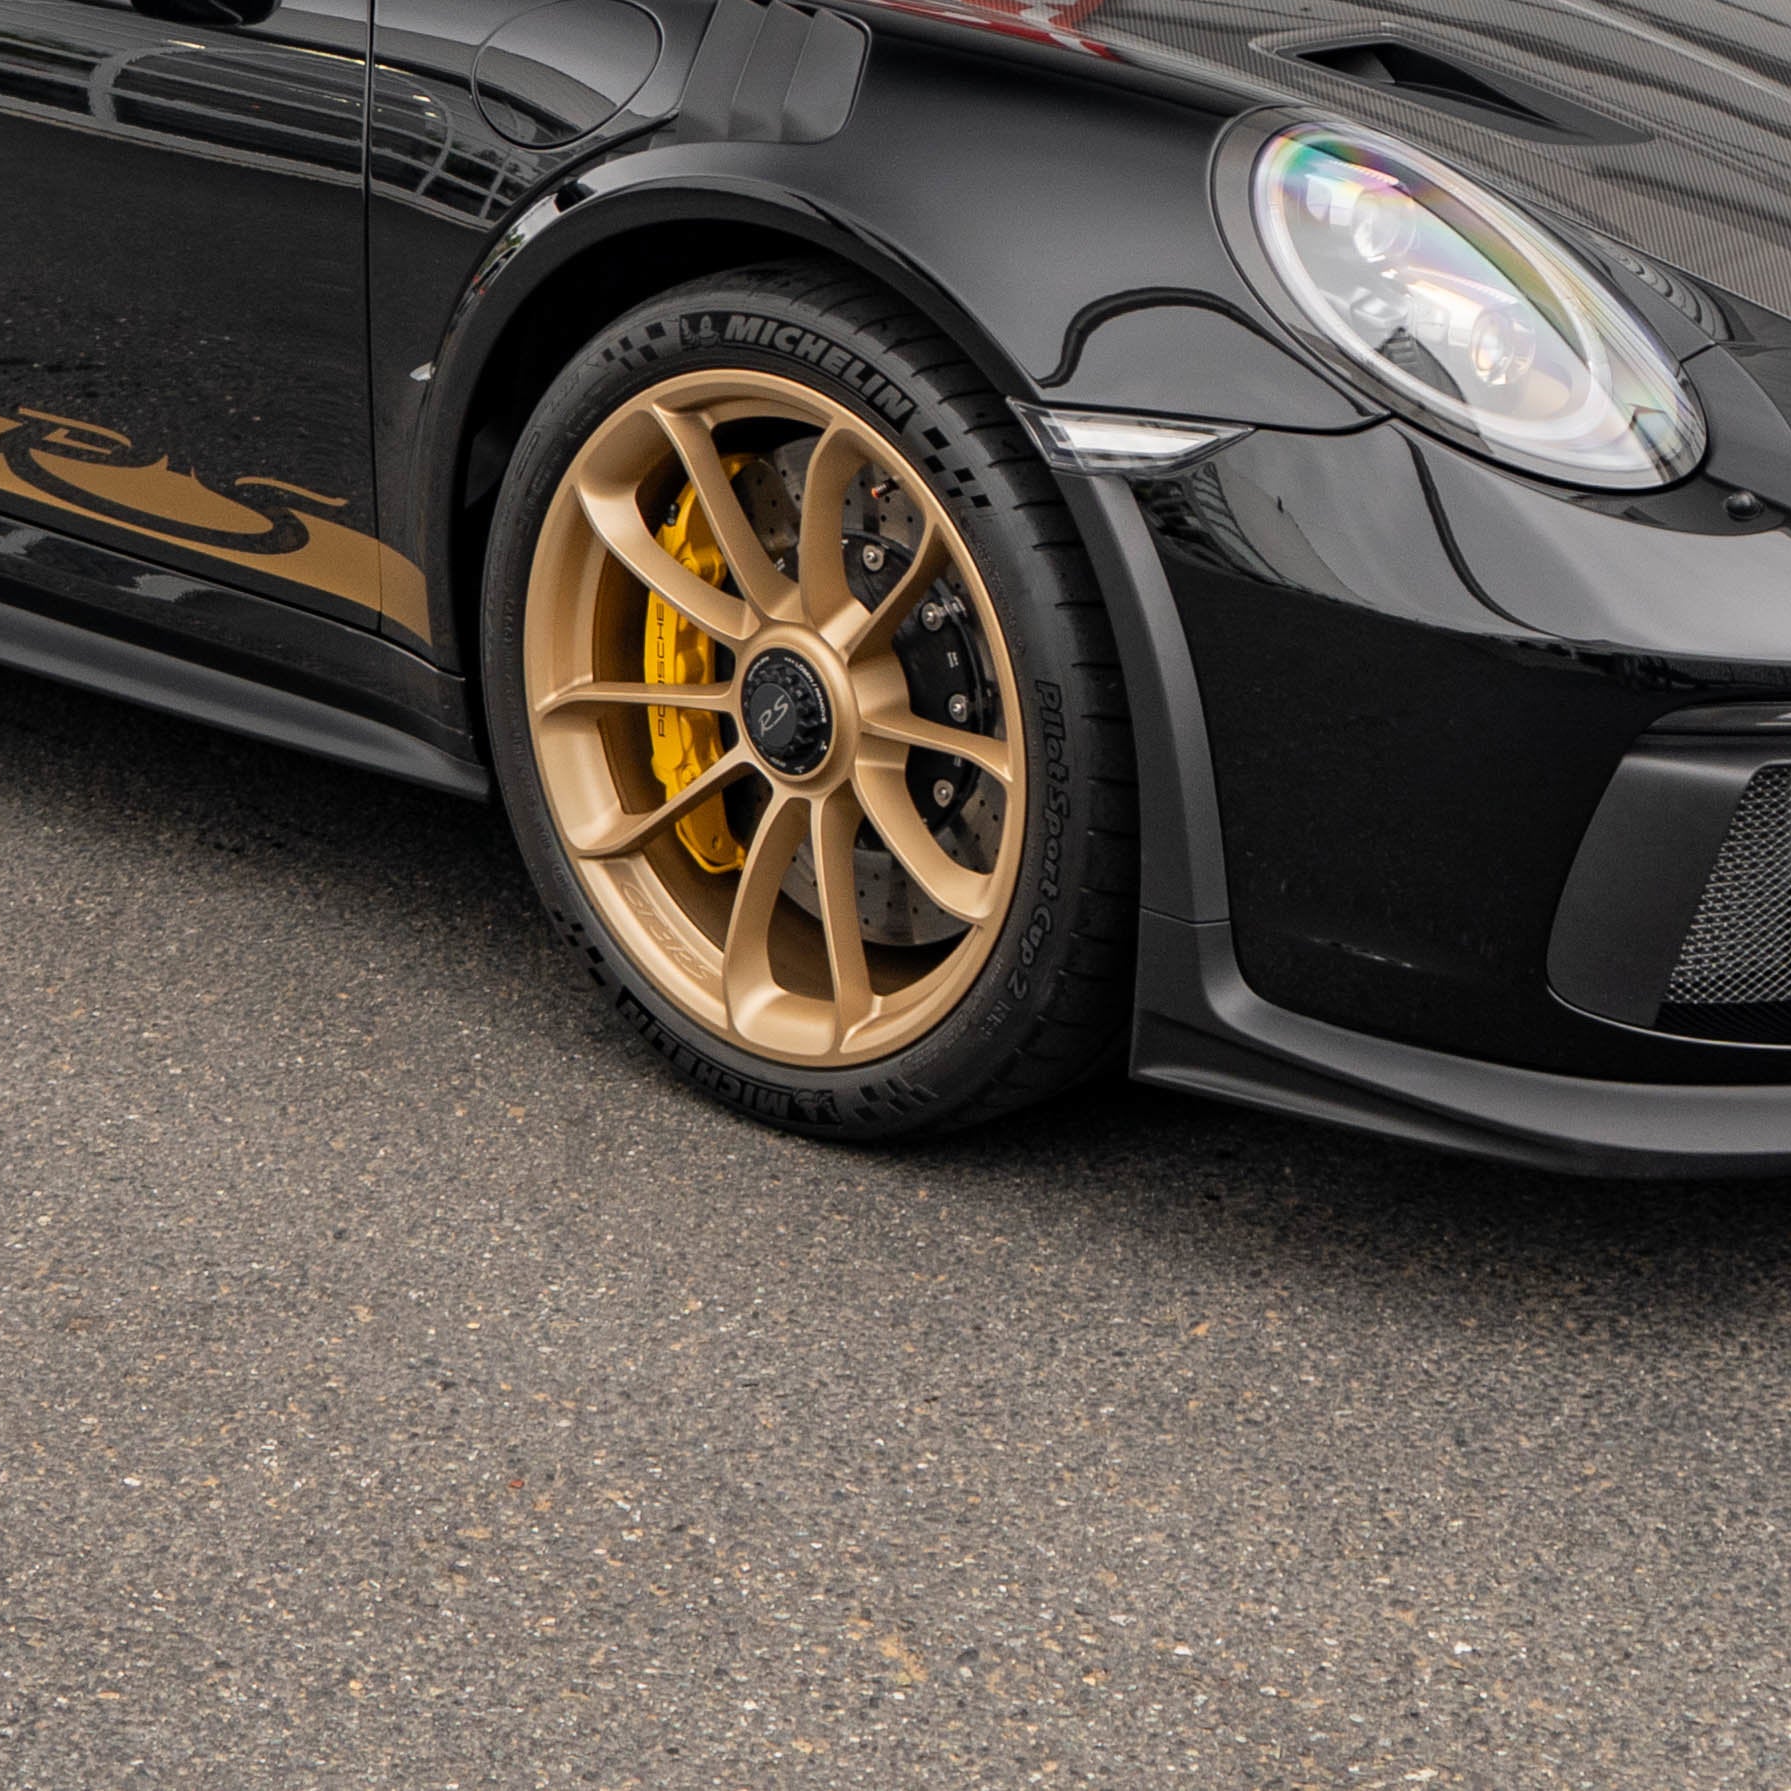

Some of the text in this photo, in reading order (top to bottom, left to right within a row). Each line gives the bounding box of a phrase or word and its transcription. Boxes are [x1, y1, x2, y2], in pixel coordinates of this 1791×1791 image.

[724, 313, 917, 421] MICHELIN
[656, 602, 666, 738] POSCHE
[758, 693, 789, 738] RS
[1007, 679, 1070, 1001] Pilot Sport Cup 2
